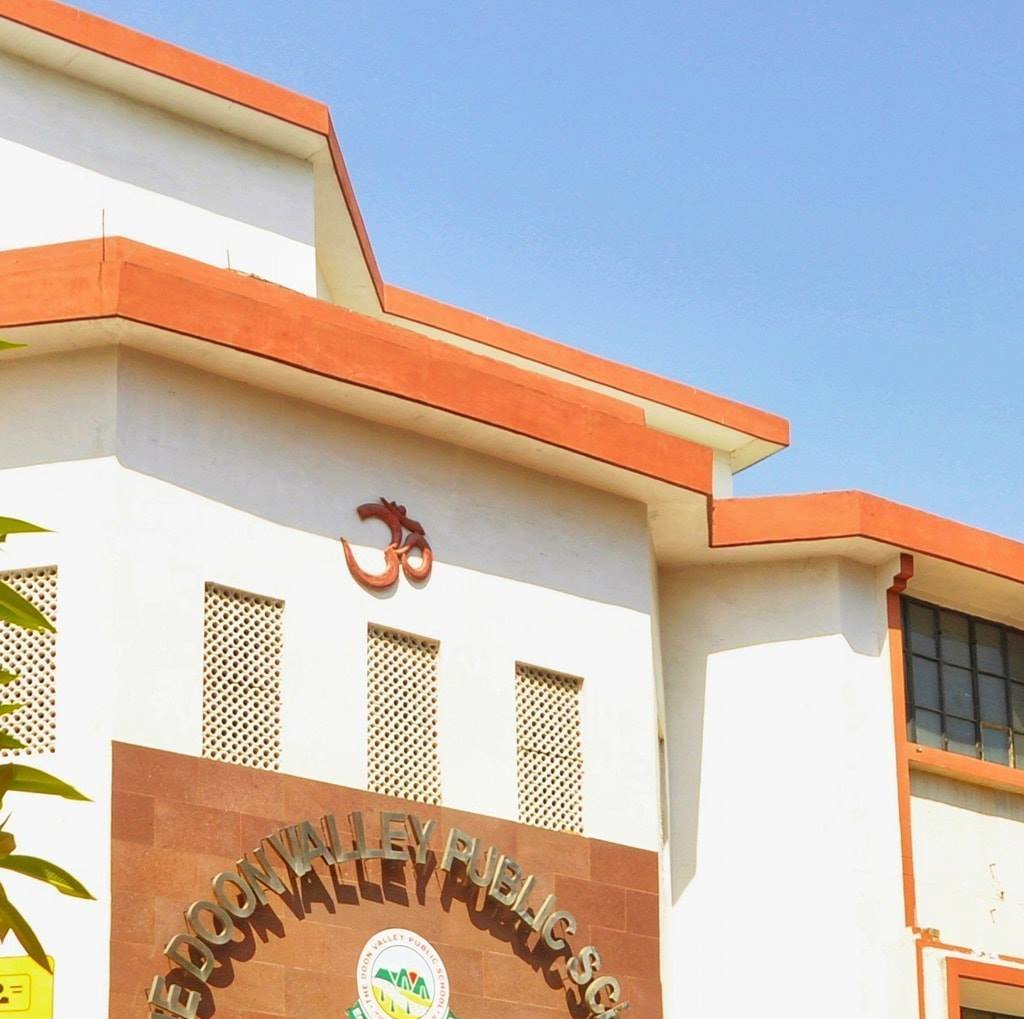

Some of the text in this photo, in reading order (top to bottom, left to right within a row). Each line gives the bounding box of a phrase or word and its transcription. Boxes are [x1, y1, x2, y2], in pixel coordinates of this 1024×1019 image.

[163, 847, 287, 983] DOON
[267, 810, 437, 877] VALLEY
[441, 828, 578, 951] PUBLIC
[361, 934, 448, 1008] THE DOON VALLEY PUBLIC SCHOOL
